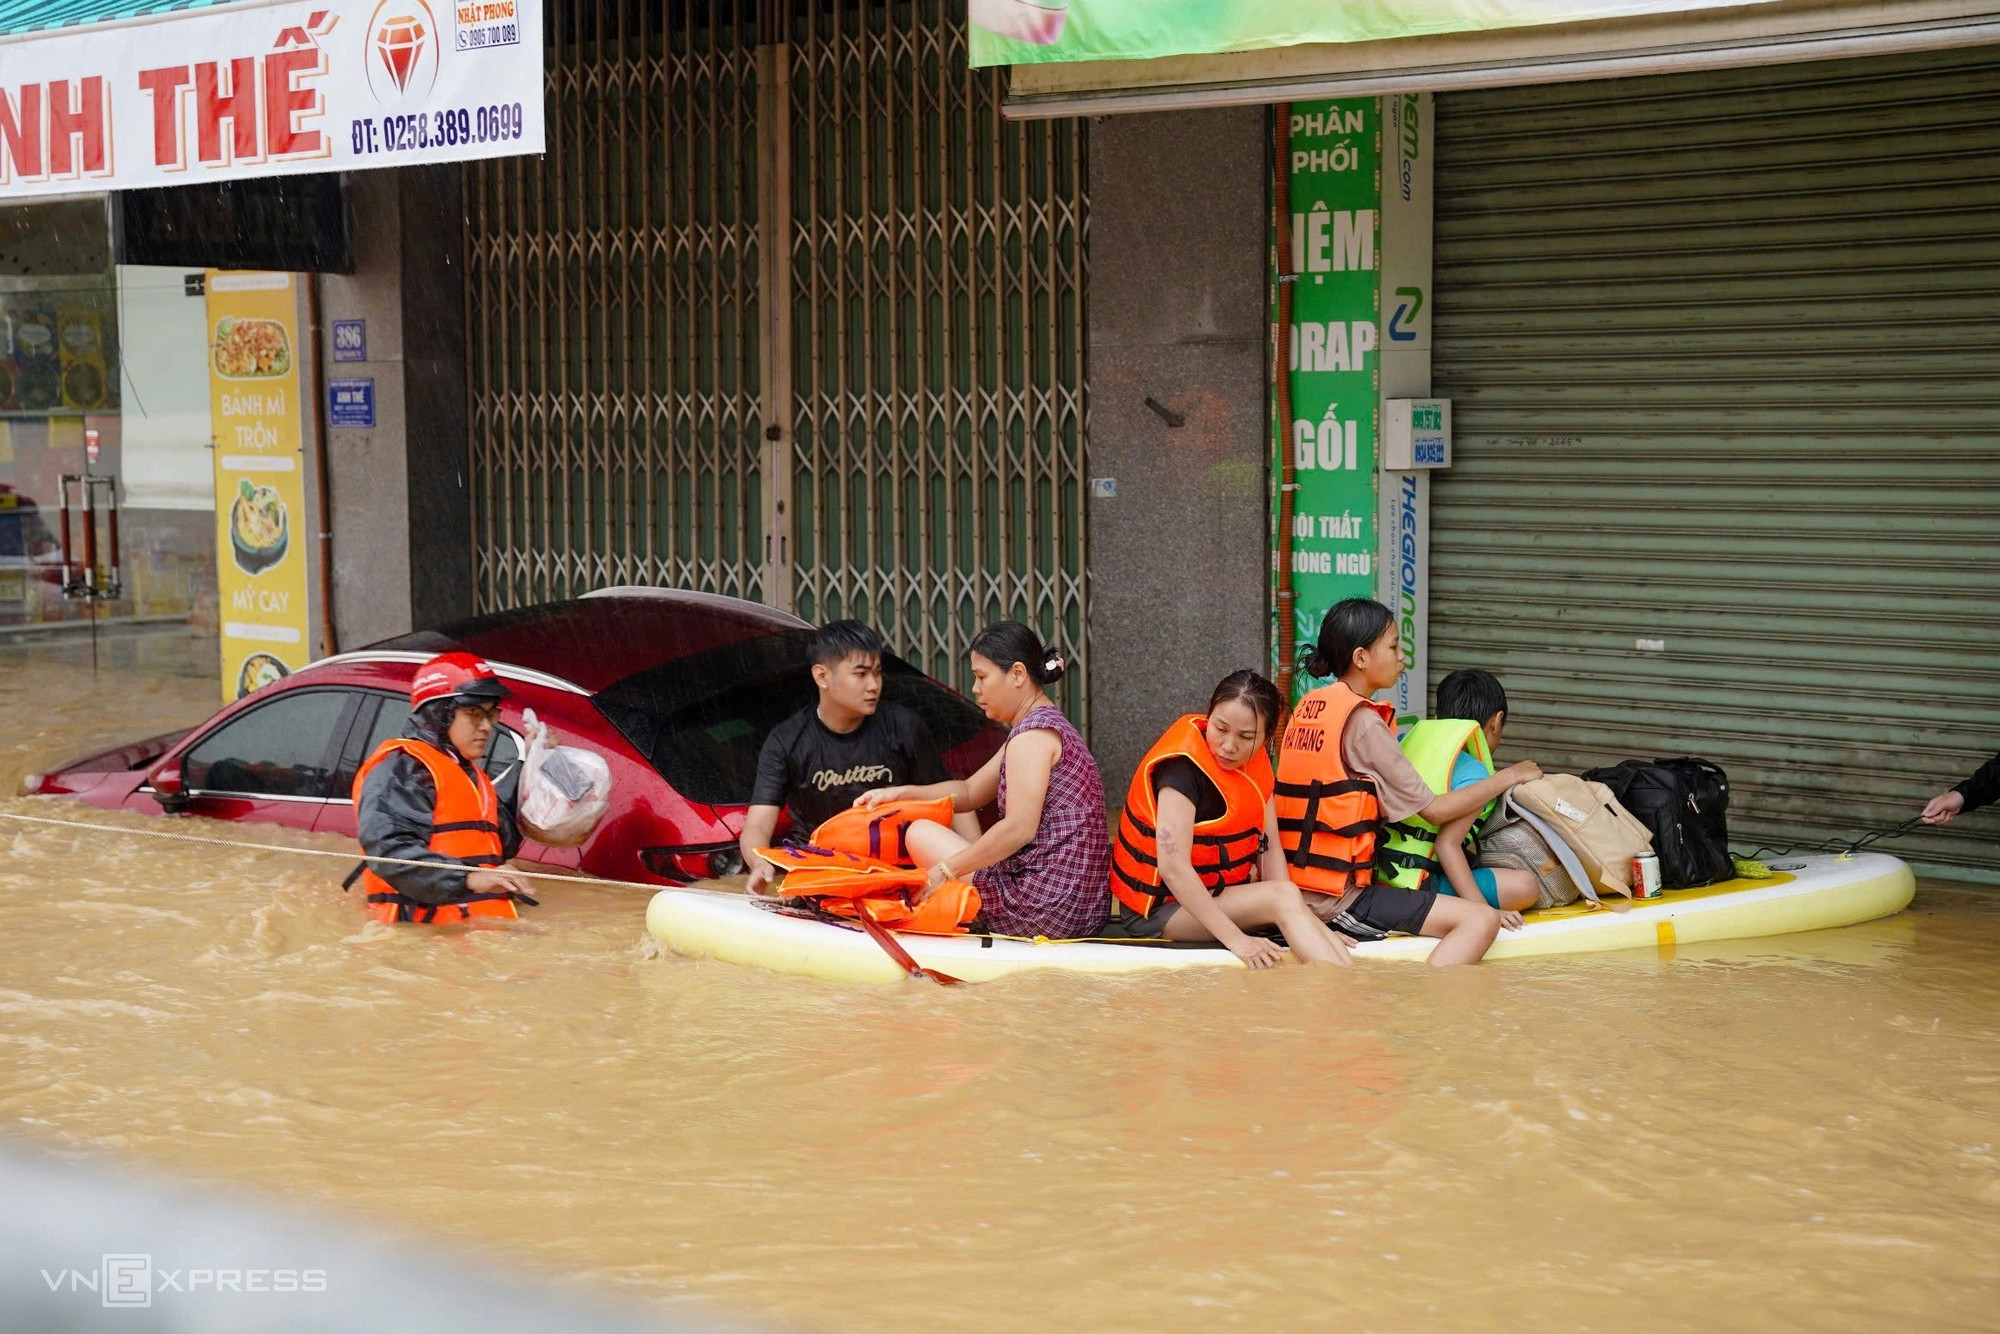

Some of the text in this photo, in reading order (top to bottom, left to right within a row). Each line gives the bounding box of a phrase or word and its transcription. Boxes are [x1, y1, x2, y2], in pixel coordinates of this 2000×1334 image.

[457, 1, 514, 27] NHẬT PHONG
[469, 24, 516, 47] 0905 700 089
[138, 10, 331, 167] THẾ
[352, 102, 523, 155] ĐT: 0258.389.0699
[1289, 105, 1364, 138] PHÂN
[1292, 138, 1359, 174] PHỐI
[221, 387, 285, 416] BÁNH MÌ
[235, 421, 278, 454] TRỘN
[1292, 403, 1357, 471] GỐI
[1318, 509, 1363, 539] THẤT
[1336, 549, 1371, 576] NGỦ
[259, 589, 289, 614] CAY
[1302, 699, 1327, 720] SUP
[1294, 727, 1325, 753] TRANG
